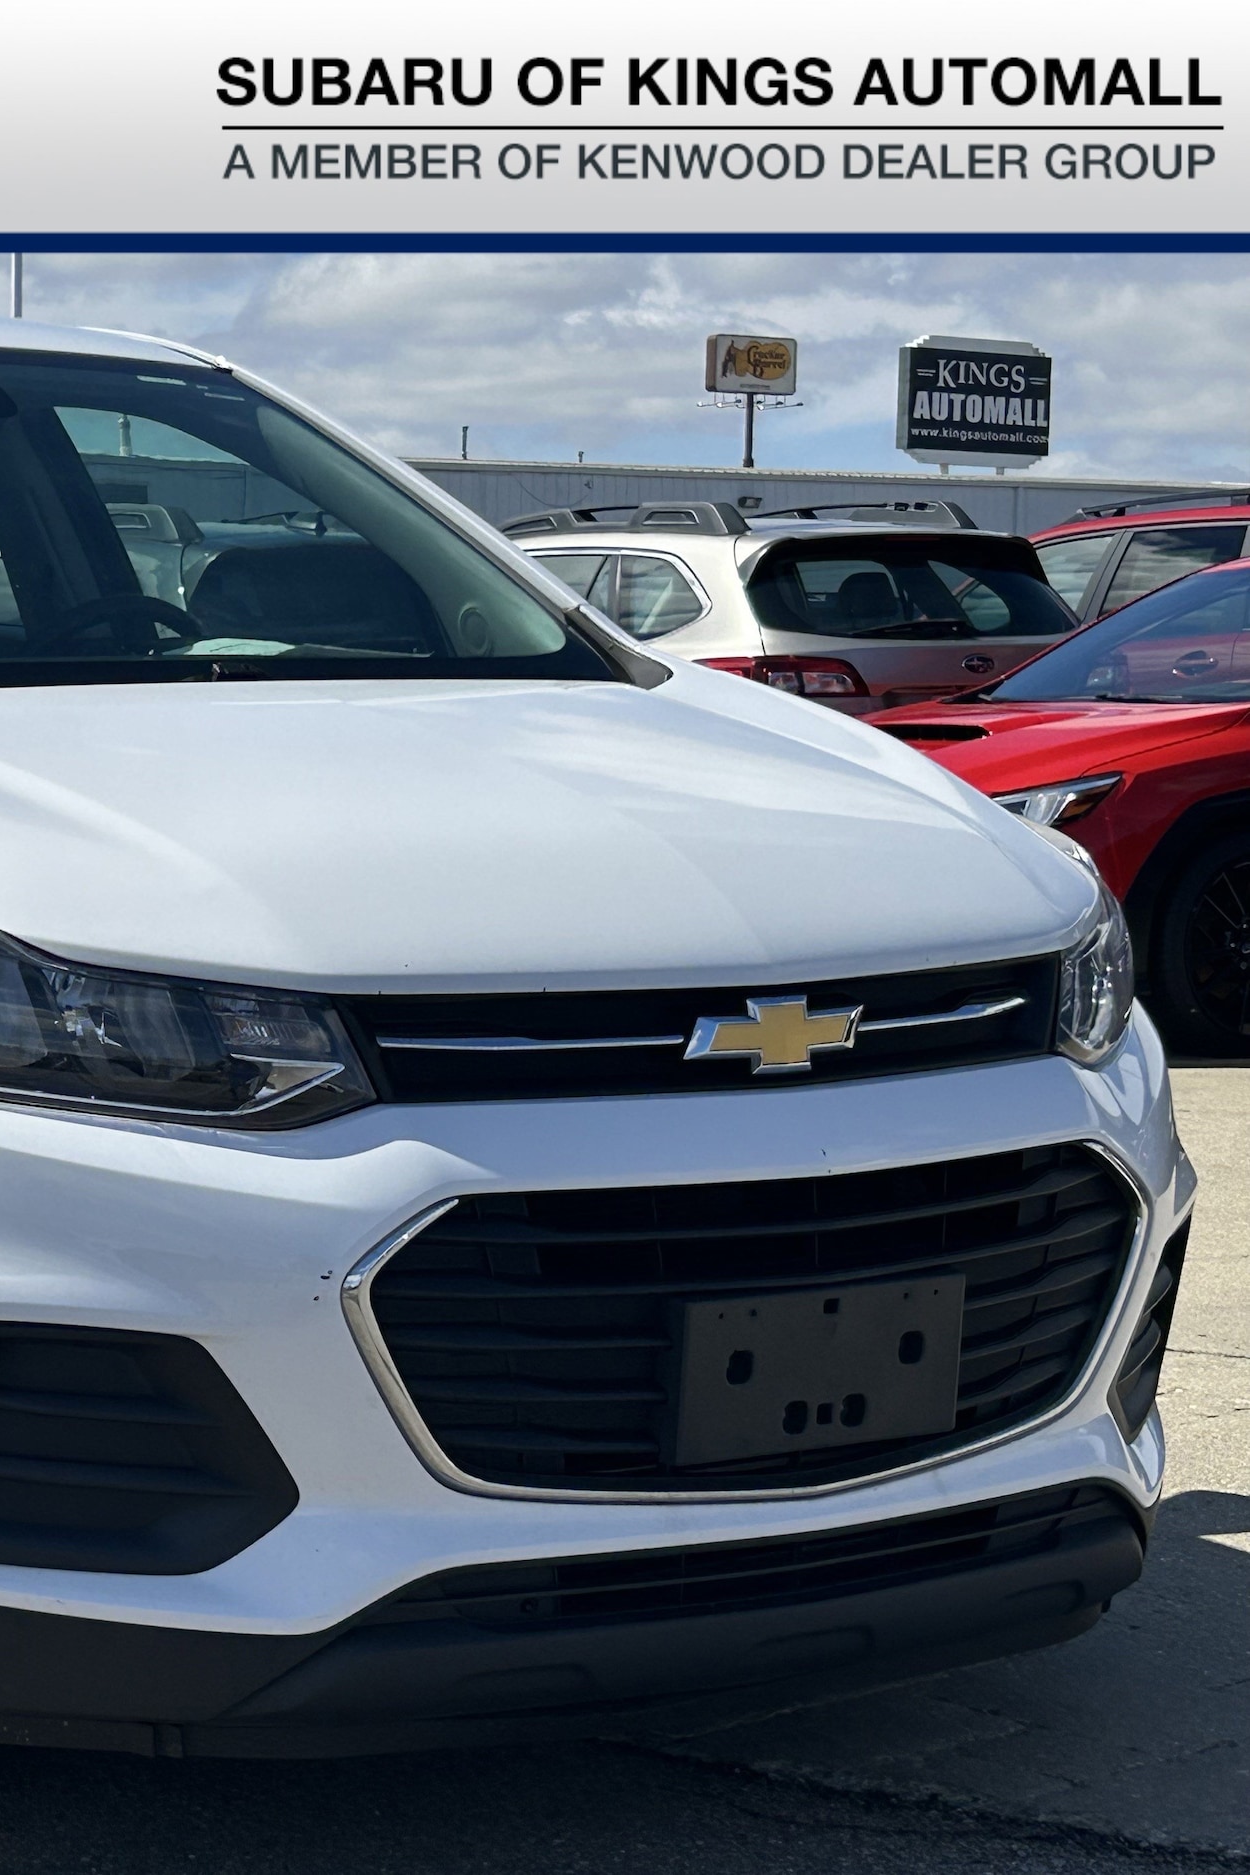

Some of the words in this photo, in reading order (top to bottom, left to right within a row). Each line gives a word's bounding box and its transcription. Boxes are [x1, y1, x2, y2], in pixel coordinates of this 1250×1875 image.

[746, 345, 786, 365] Cracker
[752, 358, 787, 377] Barrel
[936, 359, 1027, 393] KINGS
[912, 390, 1048, 427] AUTOMALL
